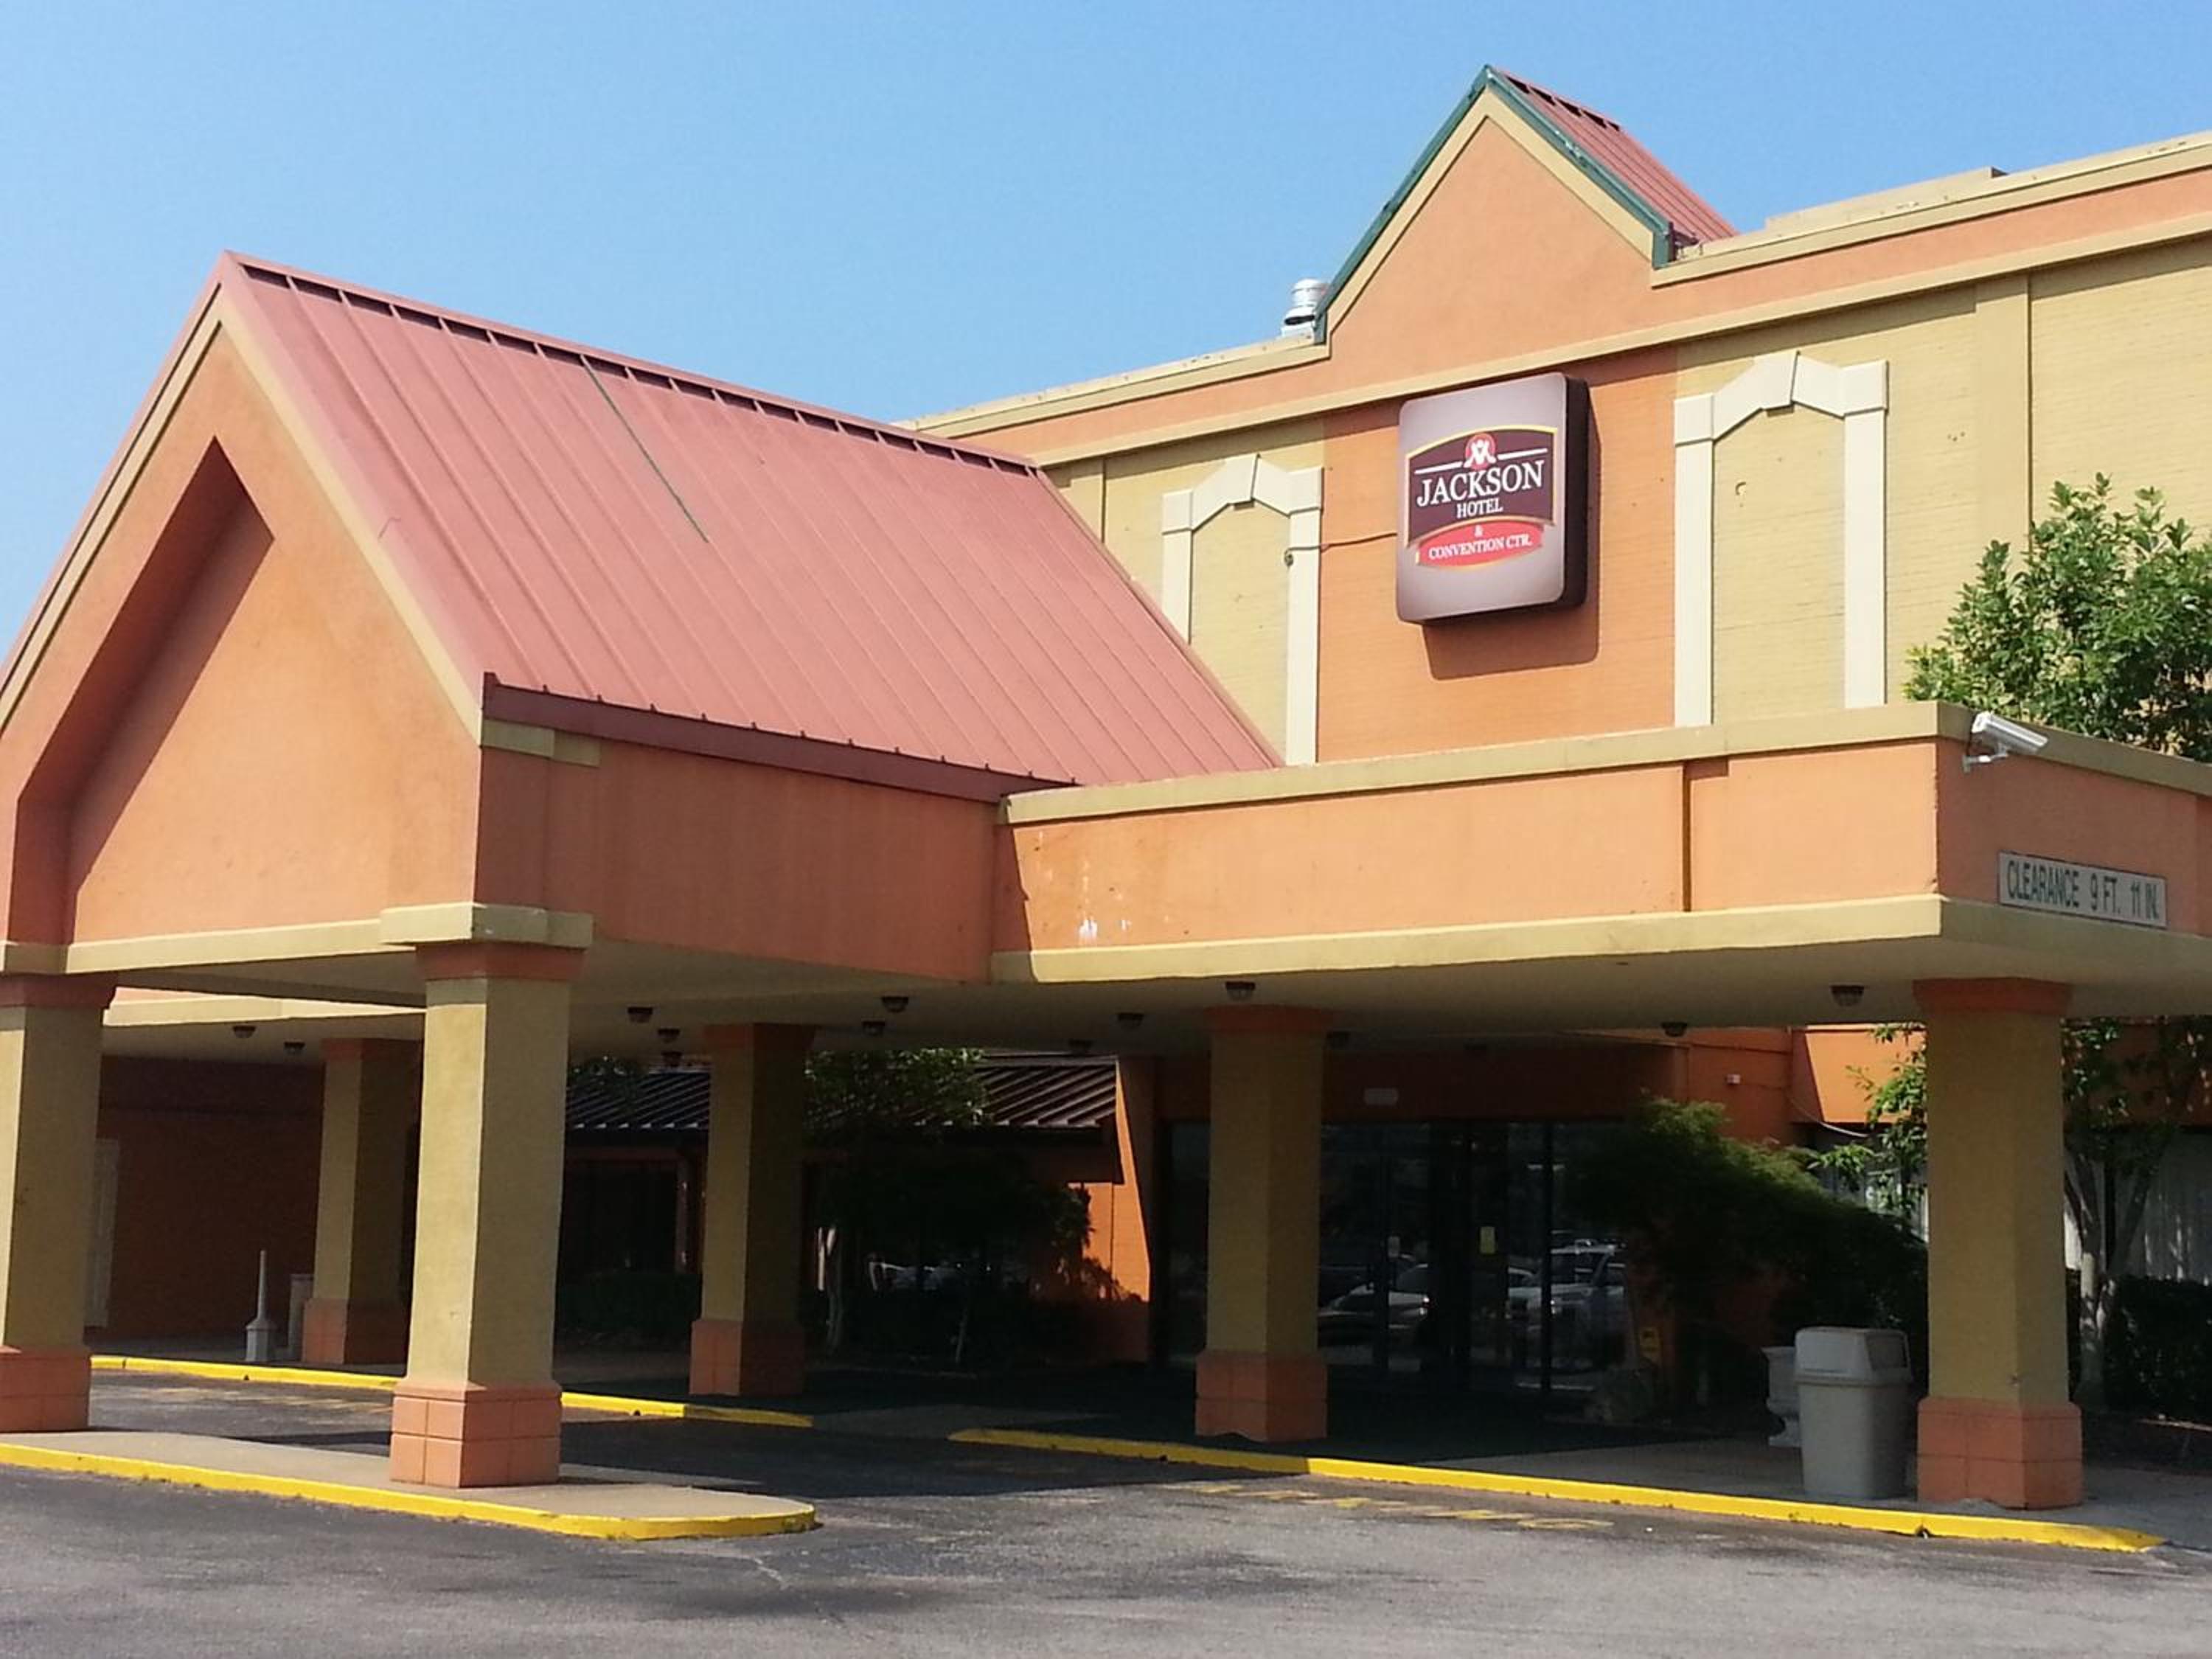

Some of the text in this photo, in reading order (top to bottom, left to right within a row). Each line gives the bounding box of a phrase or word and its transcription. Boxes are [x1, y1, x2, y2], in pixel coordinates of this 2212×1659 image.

[1416, 460, 1545, 507] JACKSON
[1456, 498, 1503, 518] HOTEL
[1428, 536, 1504, 559] CONVENTION
[2007, 860, 2079, 908] CLEARANCE
[2090, 873, 2098, 911] 9
[2131, 880, 2141, 917] 11
